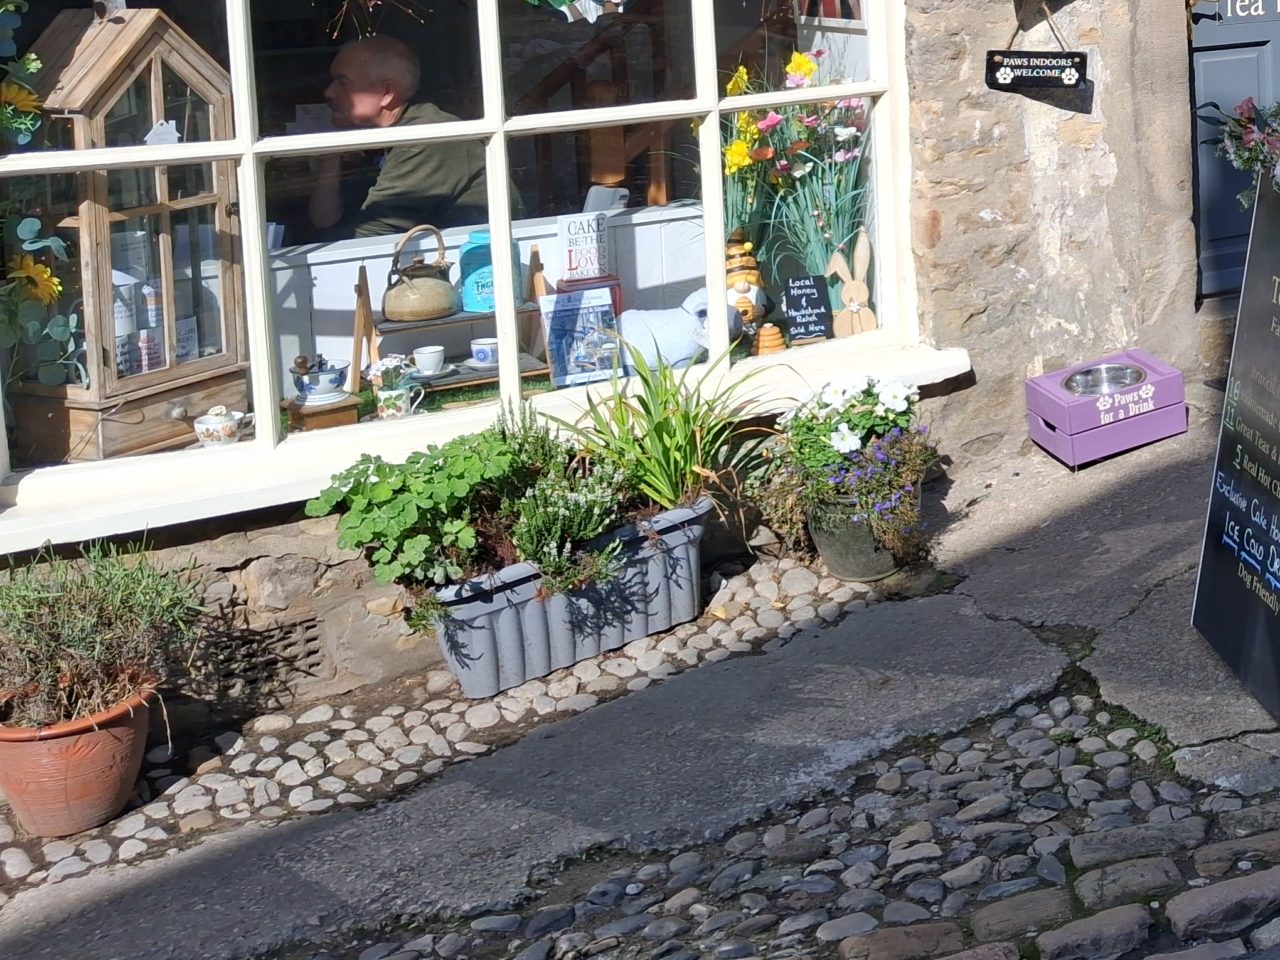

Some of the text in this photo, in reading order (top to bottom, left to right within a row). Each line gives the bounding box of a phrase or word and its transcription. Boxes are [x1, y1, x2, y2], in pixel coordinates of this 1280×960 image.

[1003, 57, 1072, 66] PAWS INDOORS
[1013, 68, 1061, 77] WELCOME
[567, 217, 606, 236] CAKE
[569, 269, 592, 279] BAKE
[789, 277, 814, 287] Local
[790, 288, 818, 298] Honey
[796, 313, 818, 323] Relish
[790, 323, 825, 334] Sold Here
[1114, 391, 1139, 407] Paws
[1100, 399, 1154, 424] for a Drink
[1235, 417, 1253, 441] Great
[1254, 430, 1270, 455] Teas
[1271, 445, 1277, 460] &
[1243, 454, 1257, 477] Real
[1258, 467, 1272, 490] Hot
[1216, 471, 1248, 512] Exclusive
[1250, 498, 1267, 530] Cake
[1238, 562, 1280, 616] Dog Friendly
